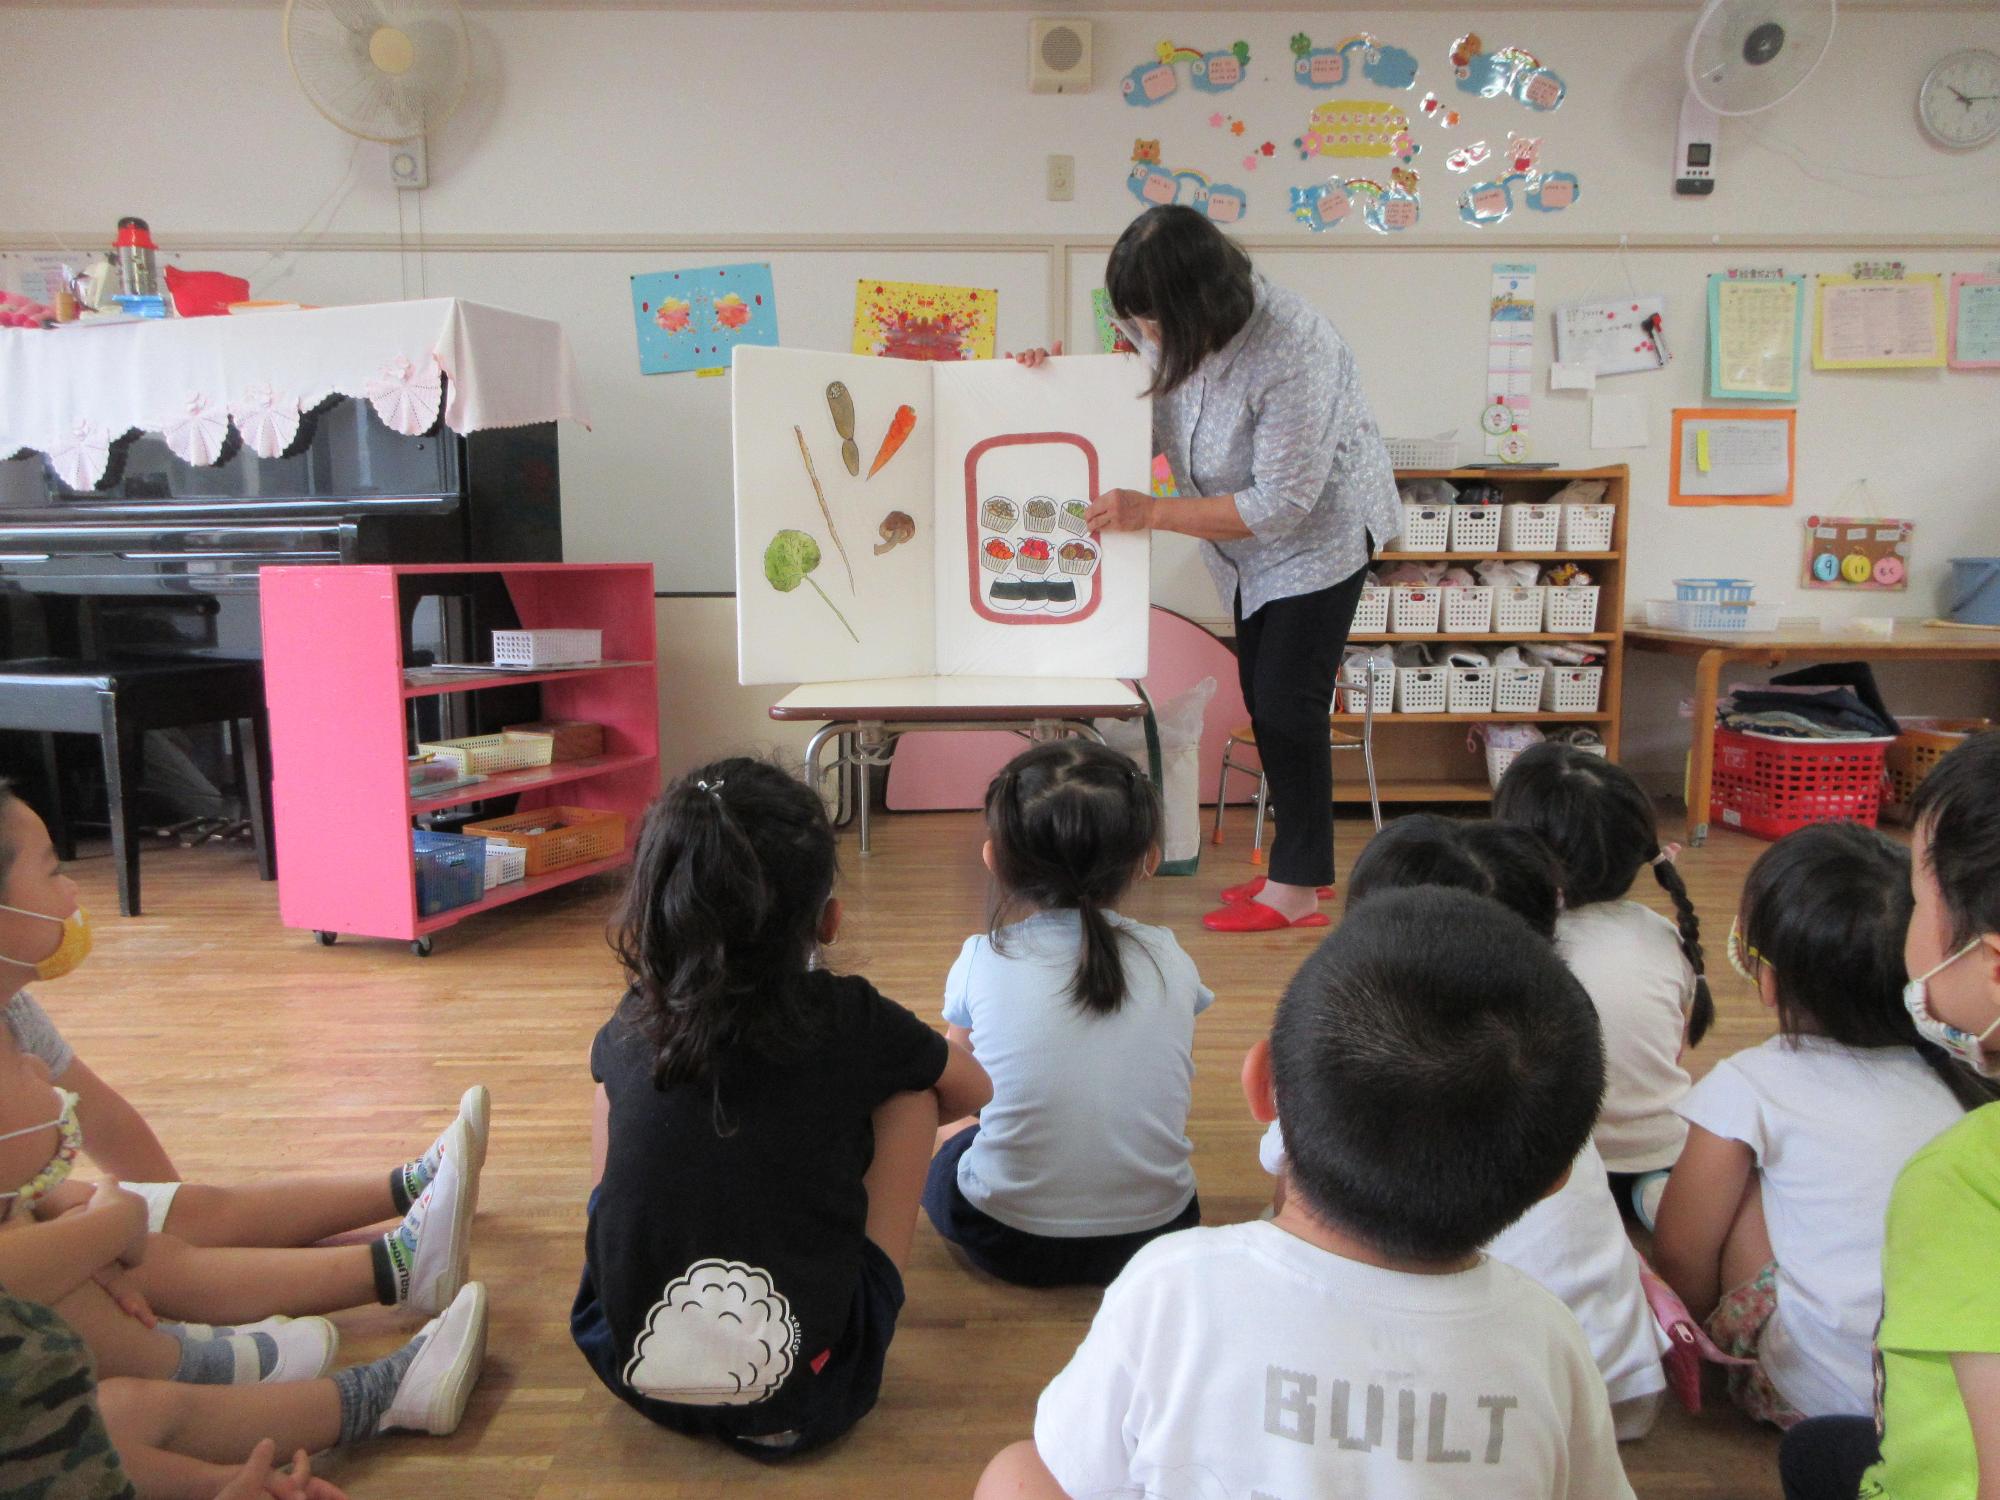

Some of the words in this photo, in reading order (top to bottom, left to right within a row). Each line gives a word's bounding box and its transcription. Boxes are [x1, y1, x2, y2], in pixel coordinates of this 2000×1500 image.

[1325, 134, 1390, 143] おめでとう
[1825, 559, 1833, 576] 9
[1264, 1364, 1518, 1464] BUILT
